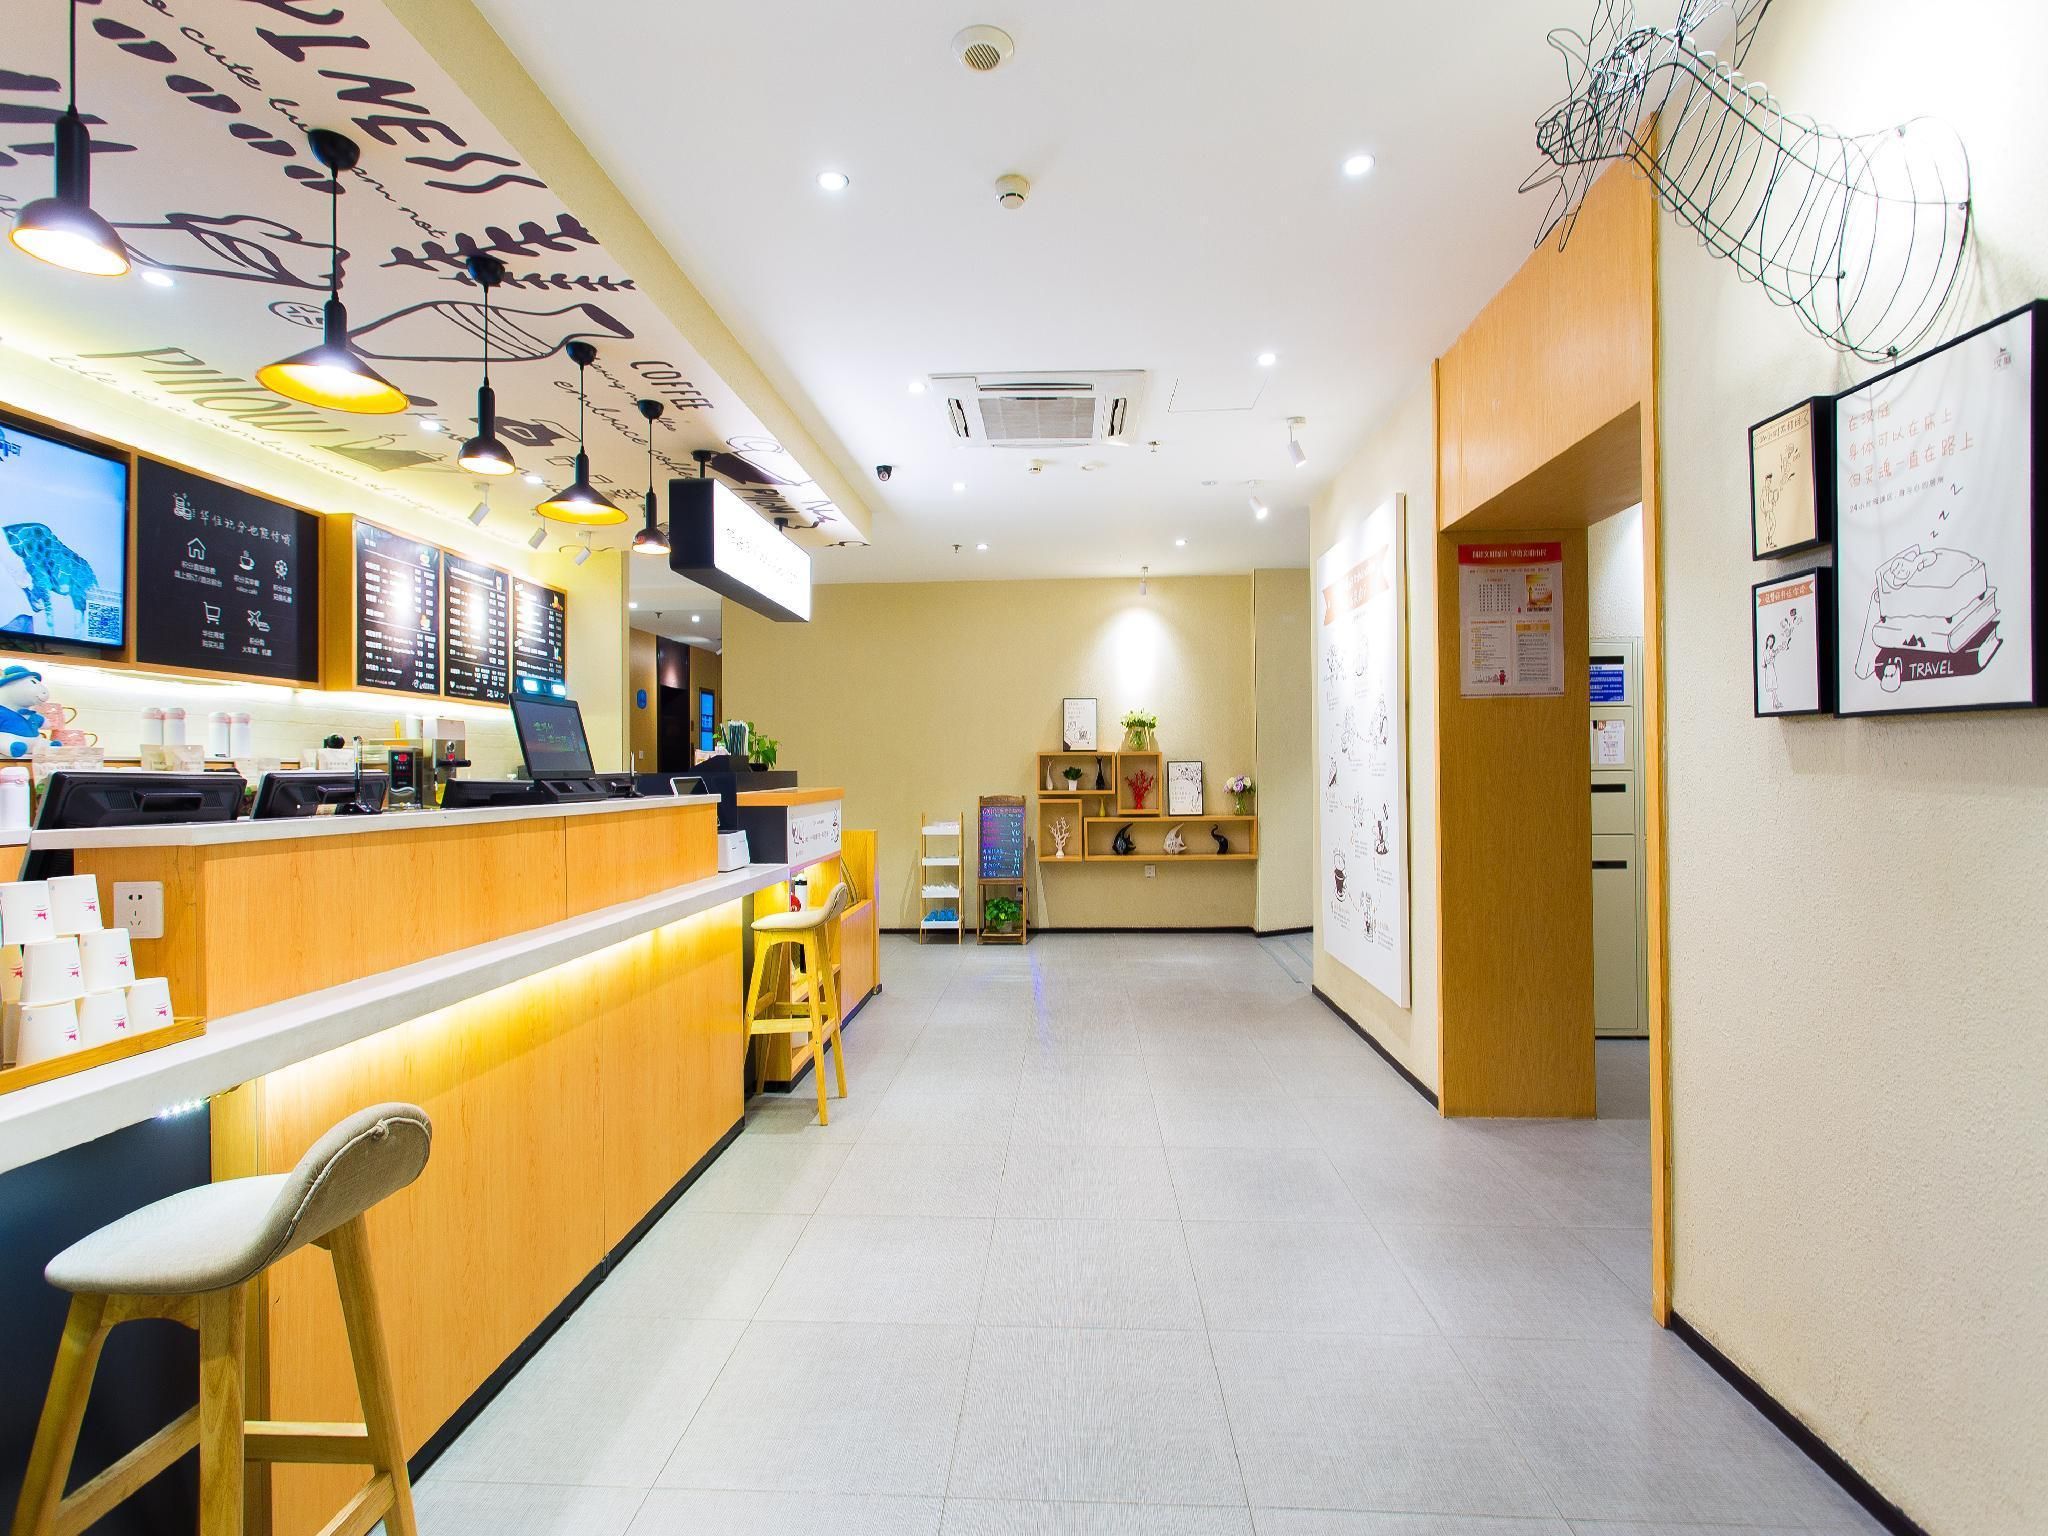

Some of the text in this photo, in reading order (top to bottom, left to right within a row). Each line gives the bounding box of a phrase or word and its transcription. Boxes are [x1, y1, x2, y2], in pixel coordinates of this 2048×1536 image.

[180, 27, 262, 91] cute
[399, 206, 448, 239] not
[630, 360, 715, 411] COFFEE
[1908, 659, 1955, 680] TRAVEL
